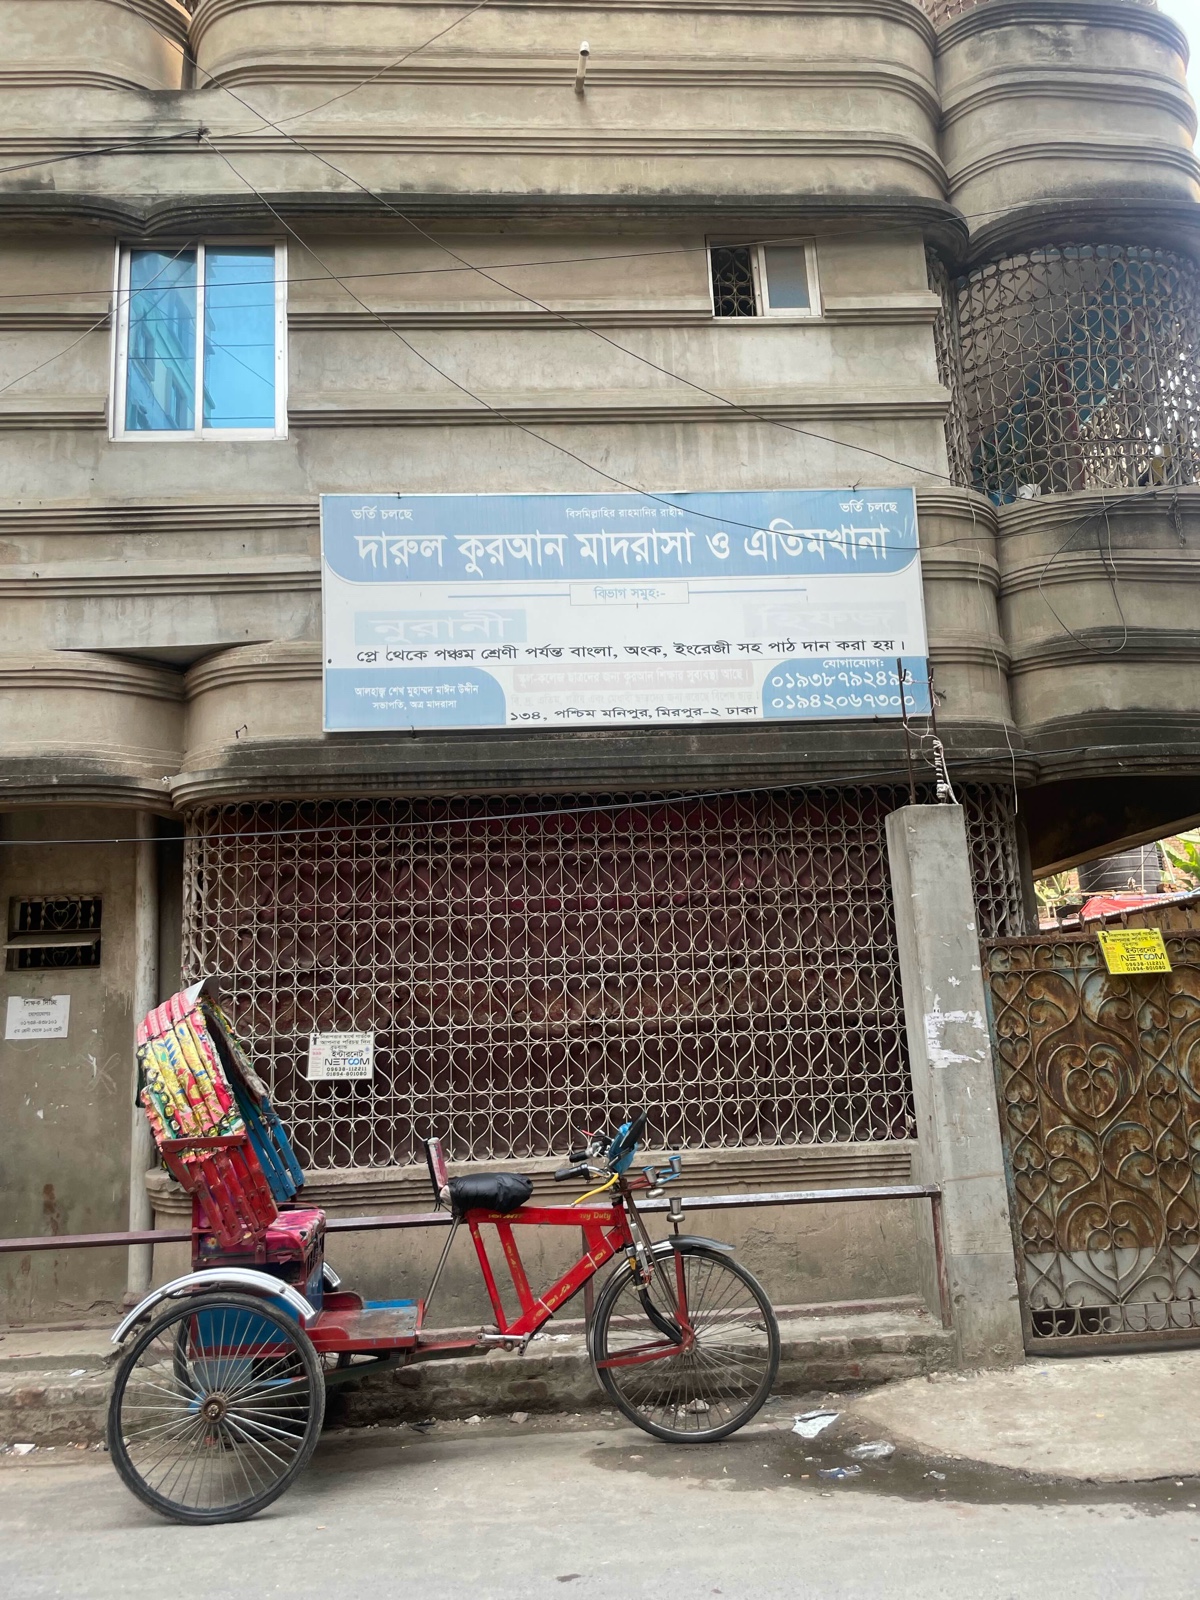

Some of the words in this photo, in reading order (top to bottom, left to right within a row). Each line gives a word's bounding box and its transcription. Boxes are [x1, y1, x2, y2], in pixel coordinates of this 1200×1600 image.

[351, 506, 378, 521] ভর্তি
[380, 509, 413, 521] চলছে
[839, 499, 864, 514] ভর্তি
[867, 501, 898, 514] চলছে
[353, 530, 447, 568] দারুল
[453, 529, 568, 578] কুরআন
[573, 528, 696, 566] মাদরাসা
[705, 531, 730, 560] ও
[744, 518, 890, 562] এতিমখানা
[357, 650, 379, 663] প্লে
[386, 649, 429, 661] থেকে
[434, 648, 476, 661] পঞ্চম
[481, 645, 519, 660] শ্রেণী
[525, 643, 565, 659] পর্যন্ত
[569, 645, 618, 660] বাংলা,
[673, 639, 732, 656] ইংরেজী
[737, 642, 762, 654] সহ
[767, 637, 797, 653] পাঠ
[801, 640, 831, 652] দান
[835, 639, 867, 652] করা
[510, 711, 548, 721] ১৩৪,
[554, 707, 597, 719] পশ্চিম
[600, 706, 653, 719] মনিপুর,
[725, 706, 758, 716] ঢাকা
[1120, 952, 1166, 961] NETCOM
[324, 1057, 370, 1066] NETCOM
[593, 1211, 611, 1220] Duty
